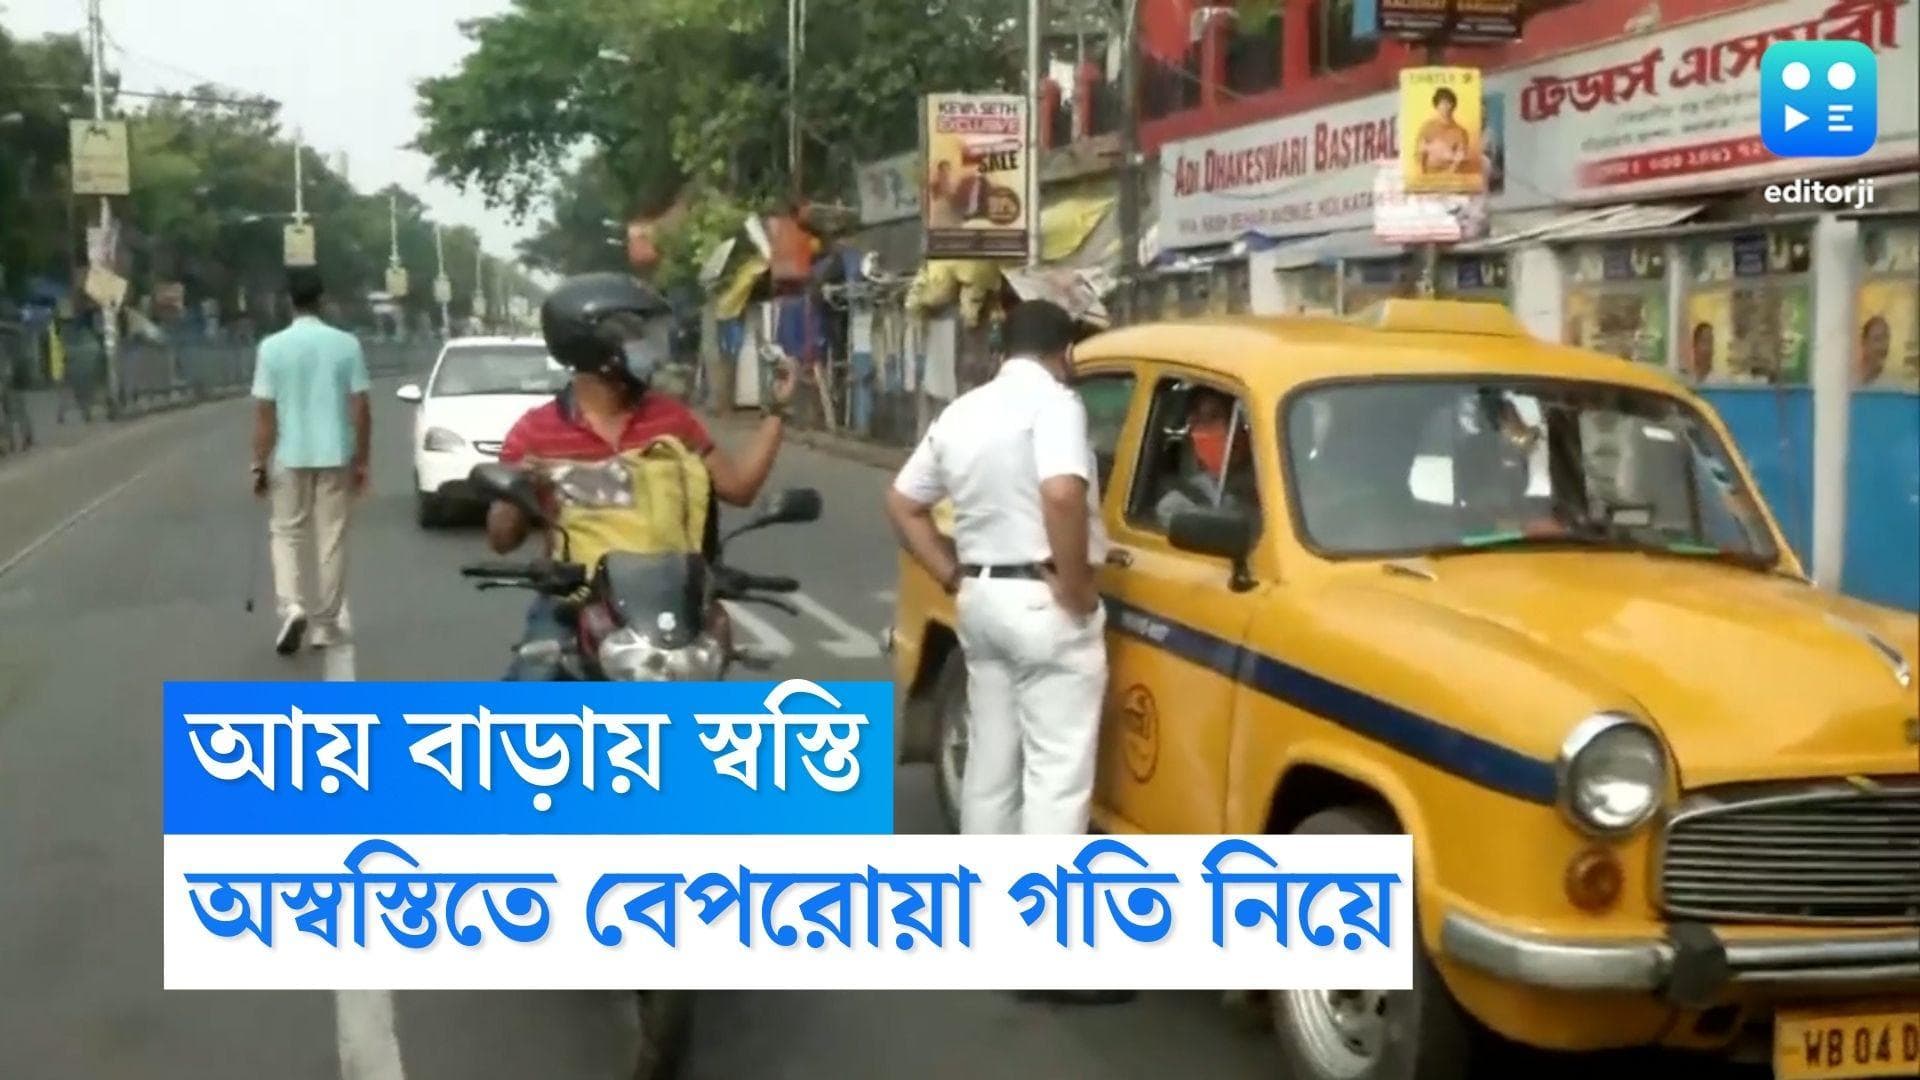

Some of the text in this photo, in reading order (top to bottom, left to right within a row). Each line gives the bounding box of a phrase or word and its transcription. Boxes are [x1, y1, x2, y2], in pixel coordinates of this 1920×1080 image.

[978, 150, 1019, 174] SALE
[1204, 136, 1308, 192] DHAKESWARI
[1803, 1028, 1843, 1068] WB
[1853, 1022, 1892, 1065] 04
